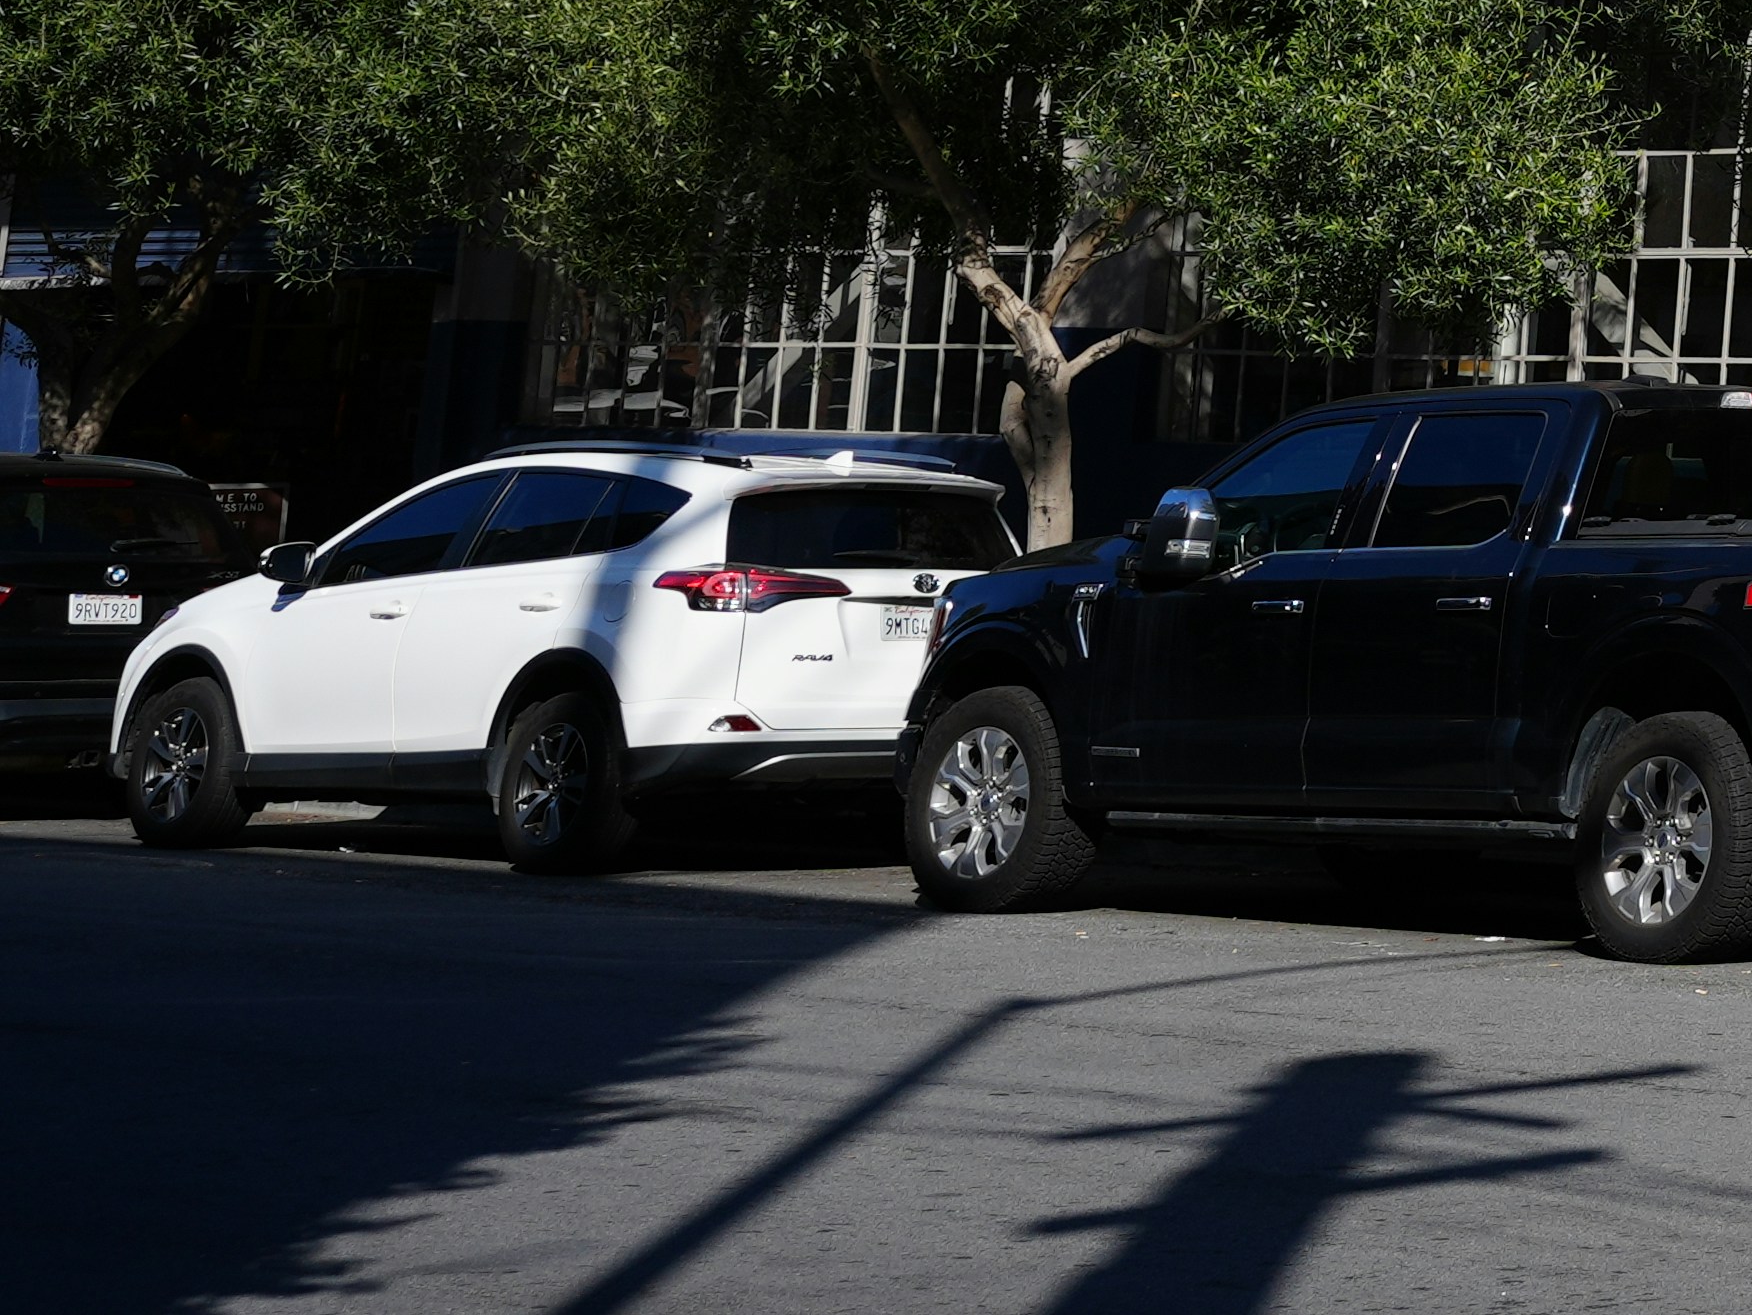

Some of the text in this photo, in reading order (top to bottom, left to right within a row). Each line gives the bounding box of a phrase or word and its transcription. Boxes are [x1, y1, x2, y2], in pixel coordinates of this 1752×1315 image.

[243, 492, 257, 502] TO
[220, 502, 265, 513] SSTAND
[75, 602, 137, 619] 9RVT920
[885, 617, 933, 635] 9MTG4
